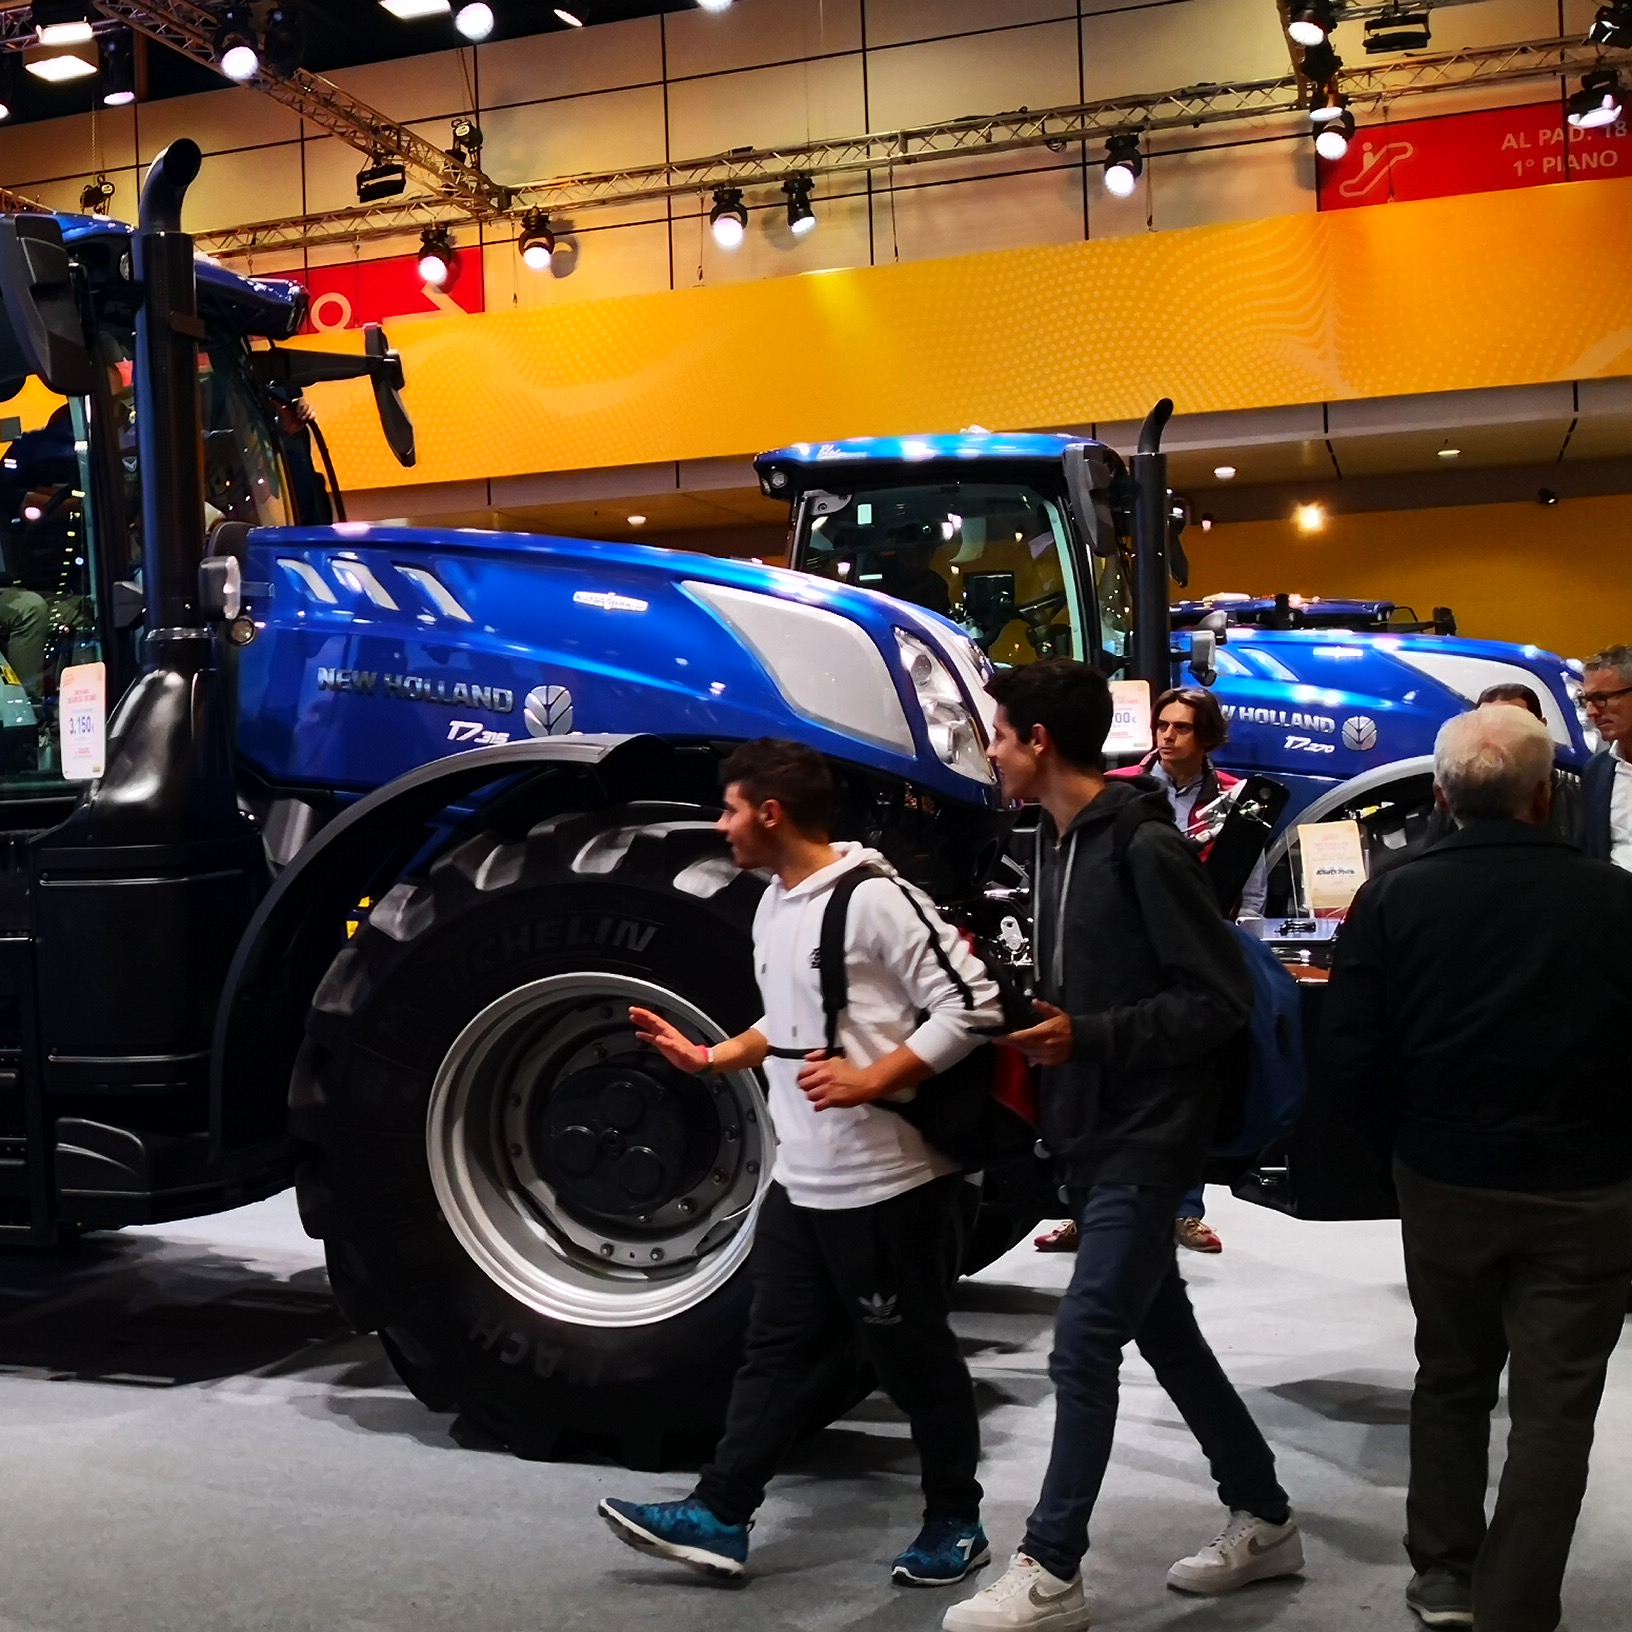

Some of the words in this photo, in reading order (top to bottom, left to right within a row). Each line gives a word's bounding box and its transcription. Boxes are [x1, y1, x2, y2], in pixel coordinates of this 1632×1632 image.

[1501, 131, 1532, 151] AL
[1538, 126, 1592, 146] PAD.
[1603, 120, 1628, 138] 18
[1542, 150, 1618, 173] PIANO
[317, 667, 378, 692] NEW
[383, 673, 514, 714] HOLLAND
[1238, 706, 1336, 734] HOLLAND
